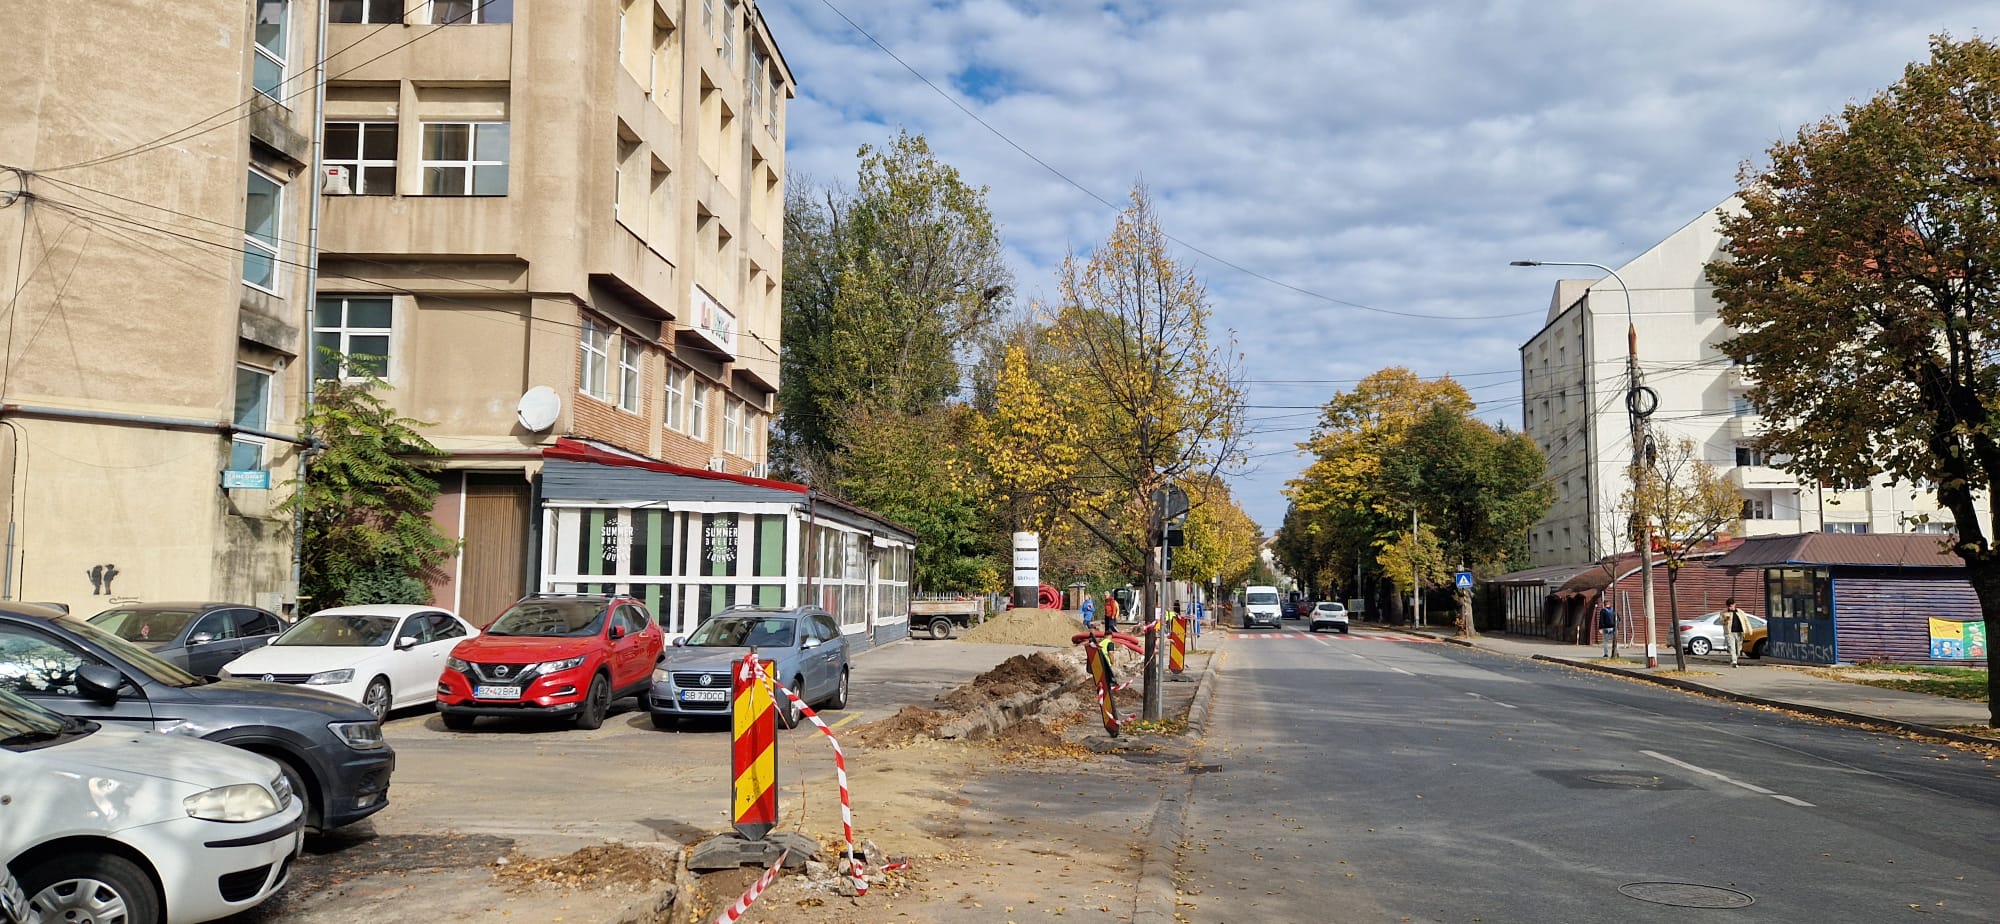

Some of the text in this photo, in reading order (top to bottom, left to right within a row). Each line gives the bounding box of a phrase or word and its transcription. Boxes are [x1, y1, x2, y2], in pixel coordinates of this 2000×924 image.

[600, 527, 634, 537] SUMMER
[705, 527, 738, 537] SUMMER
[705, 537, 738, 546] BREEZE
[706, 551, 736, 562] LOUNGE
[685, 691, 696, 700] SB
